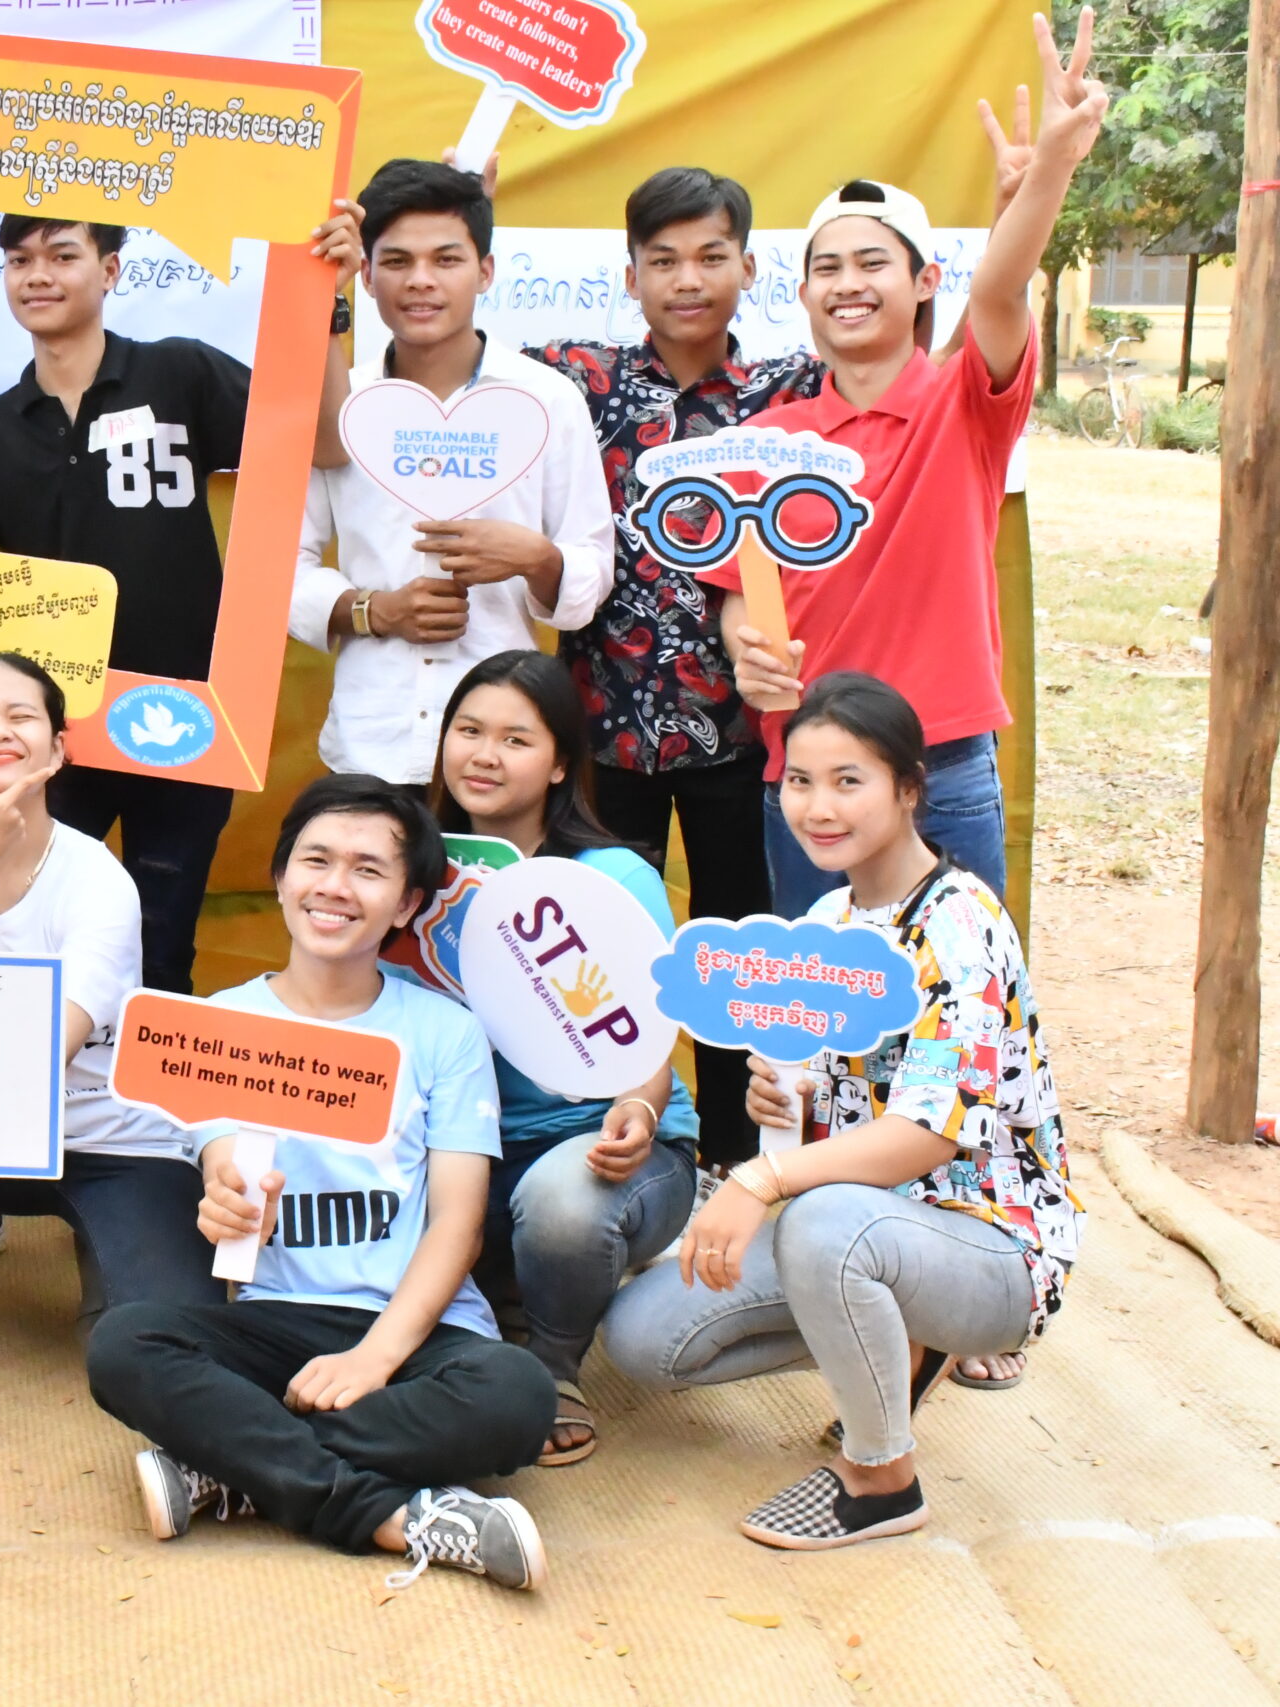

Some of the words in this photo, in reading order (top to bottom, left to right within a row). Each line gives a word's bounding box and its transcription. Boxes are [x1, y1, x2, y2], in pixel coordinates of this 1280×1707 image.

[437, 6, 465, 34] they
[466, 23, 505, 53] create
[505, 42, 539, 70] more
[478, 0, 518, 28] create
[518, 16, 578, 62] followers,
[552, 6, 589, 35] don't
[106, 423, 196, 508] 85
[394, 430, 499, 444] SUSTAINABLE
[394, 443, 498, 456] DEVELOPMENT
[393, 456, 497, 479] GOALS
[496, 920, 534, 975] Violence
[531, 975, 565, 1021] Against
[562, 1020, 596, 1068] Women
[137, 1025, 186, 1050] Don't
[193, 1036, 224, 1056] tell
[229, 1046, 251, 1061] us
[258, 1050, 305, 1072] what
[312, 1059, 330, 1076] to
[337, 1067, 388, 1090] wear,
[161, 1058, 192, 1078] tell
[197, 1068, 238, 1087] men
[244, 1076, 275, 1094] not
[282, 1081, 300, 1098] to
[306, 1087, 356, 1109] rape!
[267, 1189, 400, 1248] UMA
